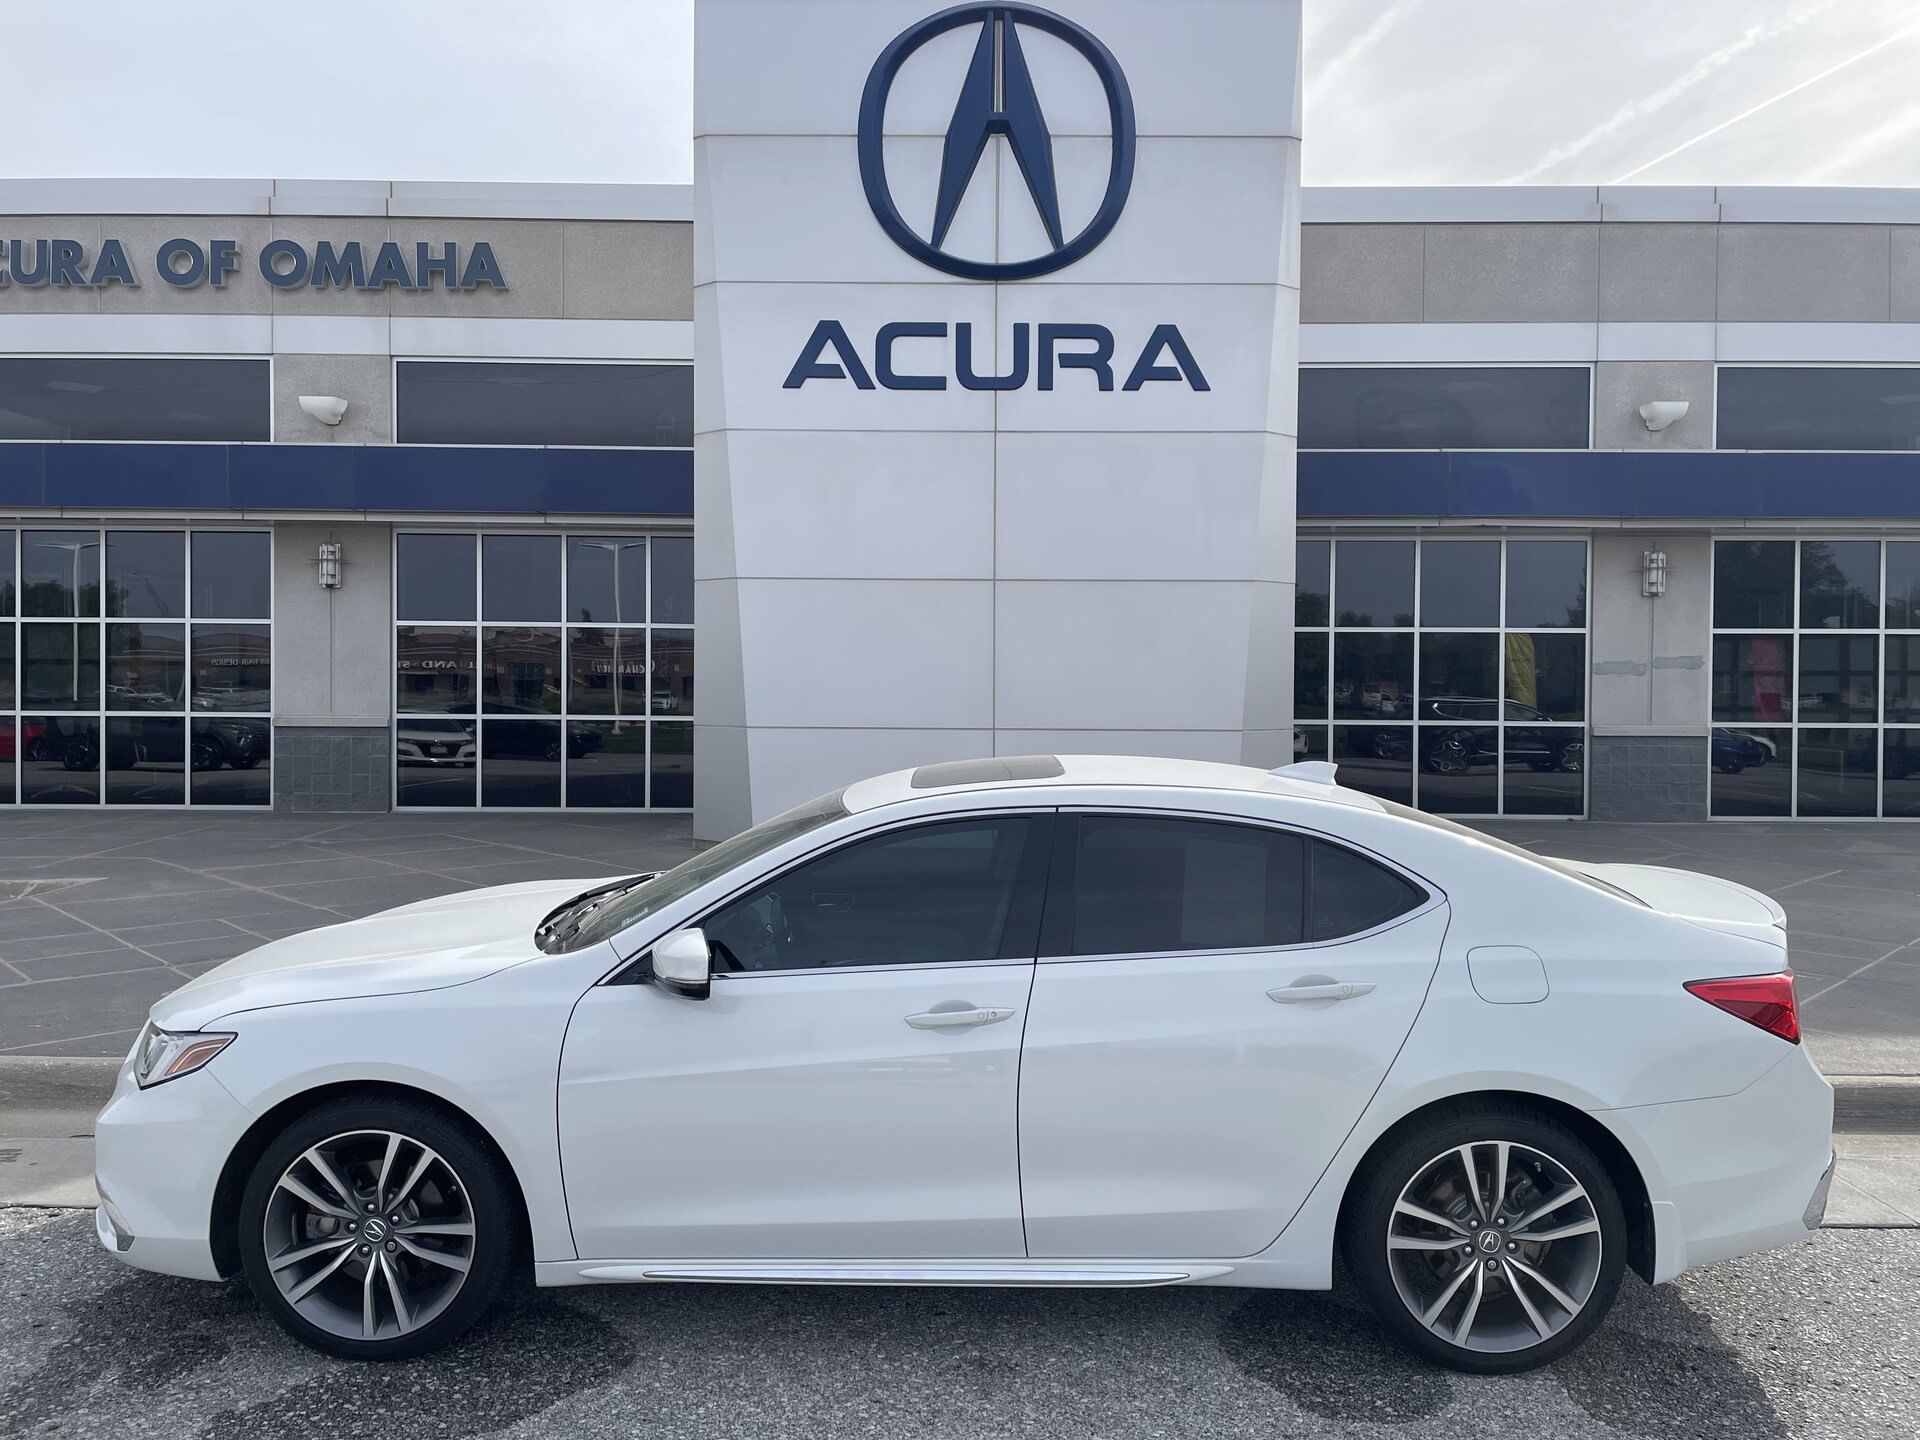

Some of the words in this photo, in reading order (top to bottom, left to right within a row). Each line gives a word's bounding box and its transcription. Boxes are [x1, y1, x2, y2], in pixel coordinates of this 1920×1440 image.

[0, 239, 138, 286] URA
[156, 238, 239, 286] OF
[258, 239, 508, 289] OMAHA
[782, 320, 1211, 391] ACURA
